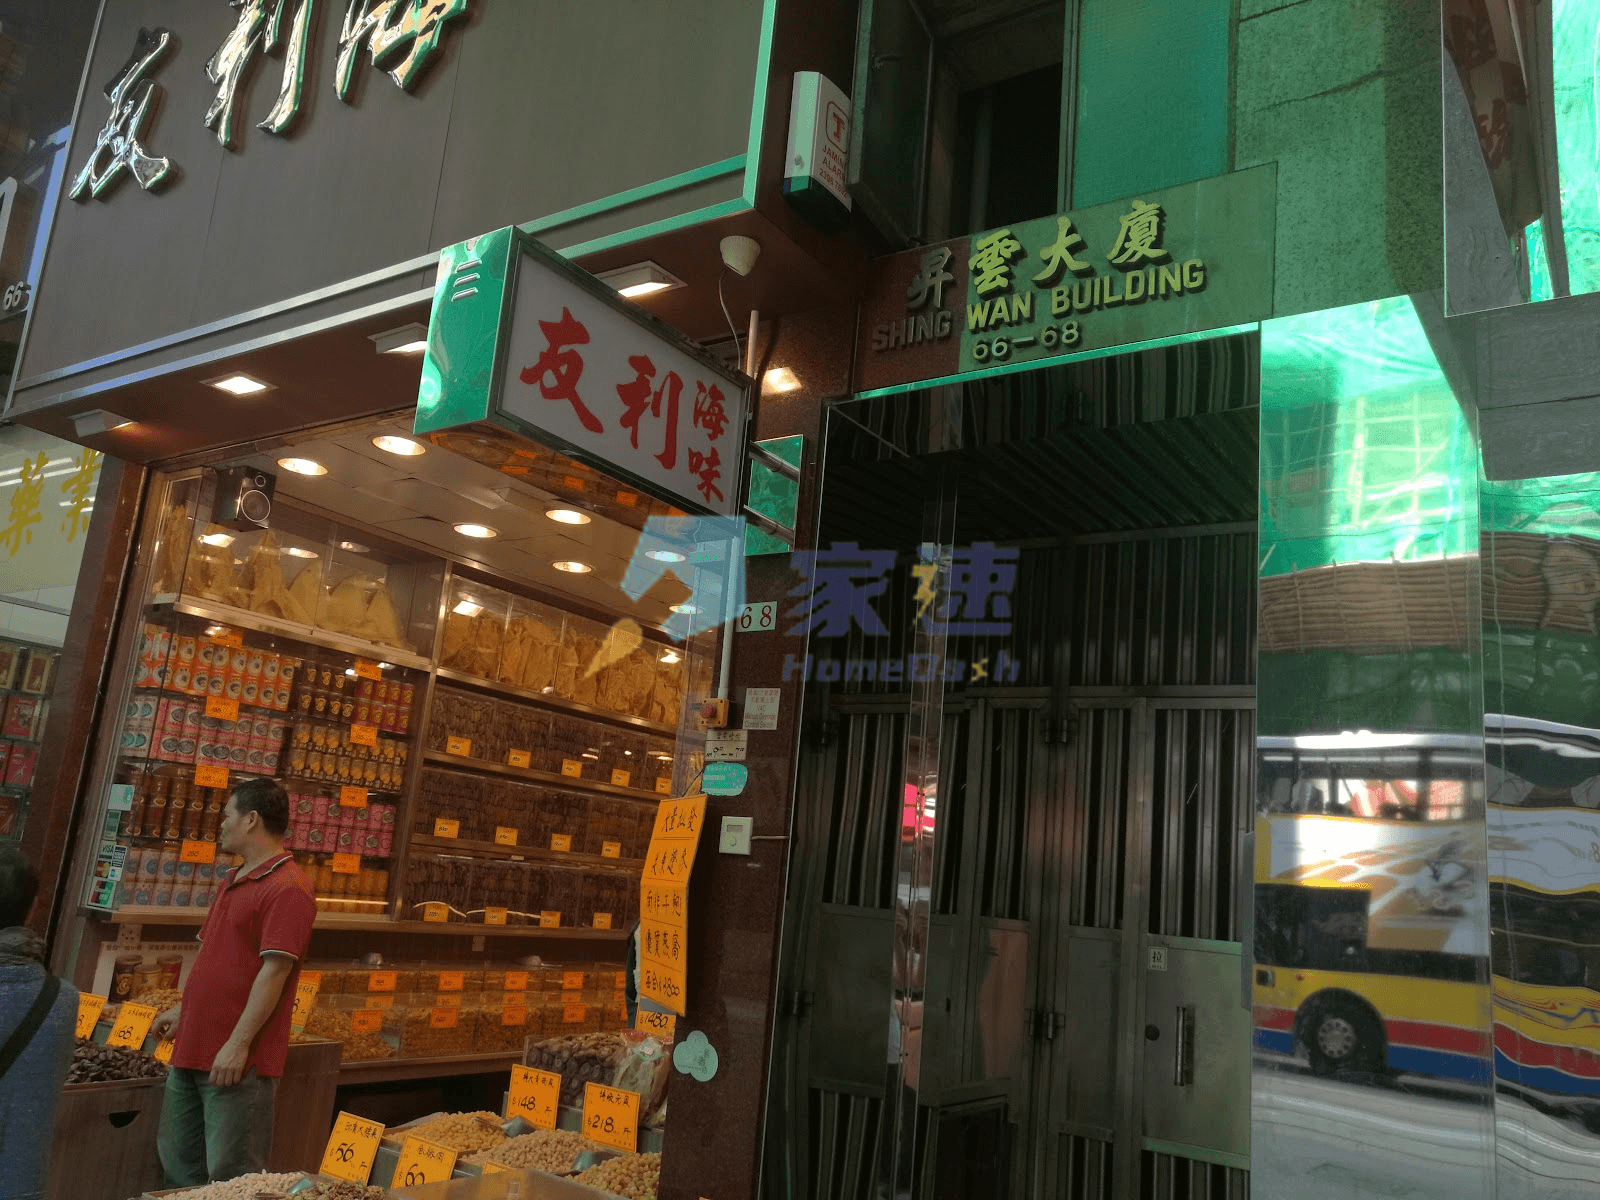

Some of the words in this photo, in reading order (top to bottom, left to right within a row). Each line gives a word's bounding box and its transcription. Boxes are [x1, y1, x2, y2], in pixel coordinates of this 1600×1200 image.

[871, 310, 952, 354] SHING
[966, 290, 1031, 332] WAN
[1051, 257, 1205, 318] BUILDING
[519, 306, 684, 470] 友利
[687, 379, 731, 503] 海味
[740, 606, 773, 629] 68
